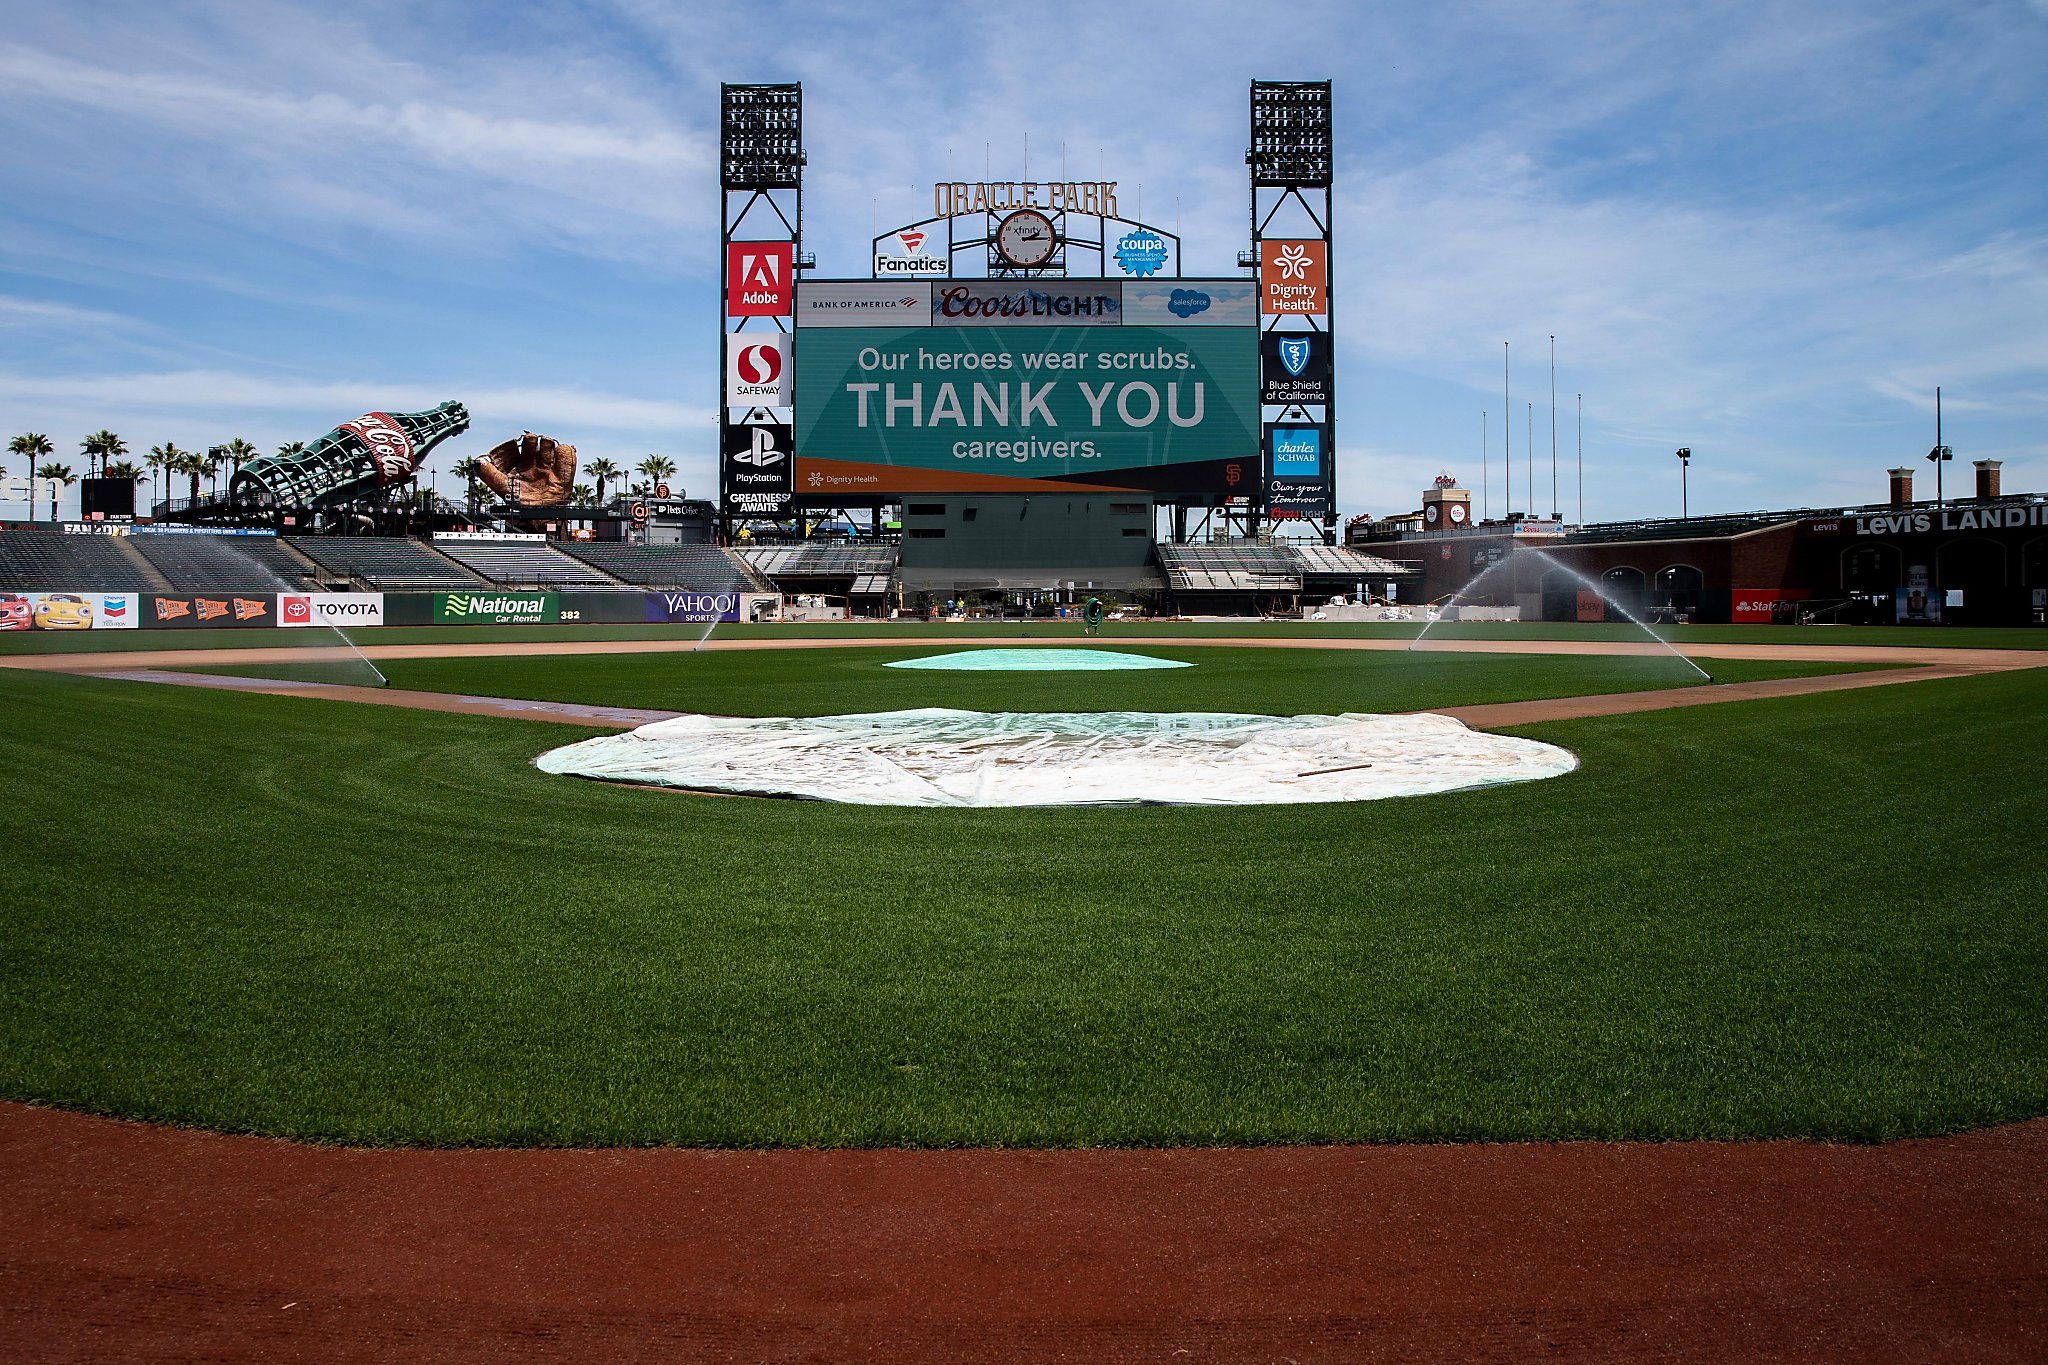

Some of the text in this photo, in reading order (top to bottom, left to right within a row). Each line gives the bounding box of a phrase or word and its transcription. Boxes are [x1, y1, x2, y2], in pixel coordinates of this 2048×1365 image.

[935, 182, 1119, 219] ORACLE PARK
[1013, 226, 1041, 236] xfinity
[1121, 239, 1163, 254] coupa
[877, 256, 947, 271] Fanatics
[1270, 283, 1317, 298] Dignity
[742, 291, 778, 304] Adobe
[940, 286, 1107, 318] Coors LIGHT
[1173, 299, 1207, 307] salesforce
[812, 301, 838, 309] BANK
[858, 346, 1196, 370] Our heroes wear scrubs.
[736, 386, 781, 395] SAFEWAY
[1269, 380, 1321, 390] Blue Shield
[1266, 391, 1325, 400] of California
[846, 381, 1205, 428] THANK YOU
[952, 435, 1102, 463] caregivers.
[1277, 441, 1315, 453] charles
[1277, 454, 1315, 462] SCHWAB
[736, 473, 782, 484] PlayStation
[826, 475, 853, 484] Dignity
[1435, 475, 1456, 484] Coors
[1270, 480, 1323, 497] Own your
[730, 493, 791, 503] GREATNESS
[1270, 494, 1325, 504] tomorrow
[740, 502, 779, 512] AWAITS
[1270, 507, 1326, 518] Coors LIGHT
[468, 597, 545, 613] National
[664, 593, 736, 614] YAHOO!
[316, 604, 379, 615] TOYOTA
[560, 611, 580, 620] 382
